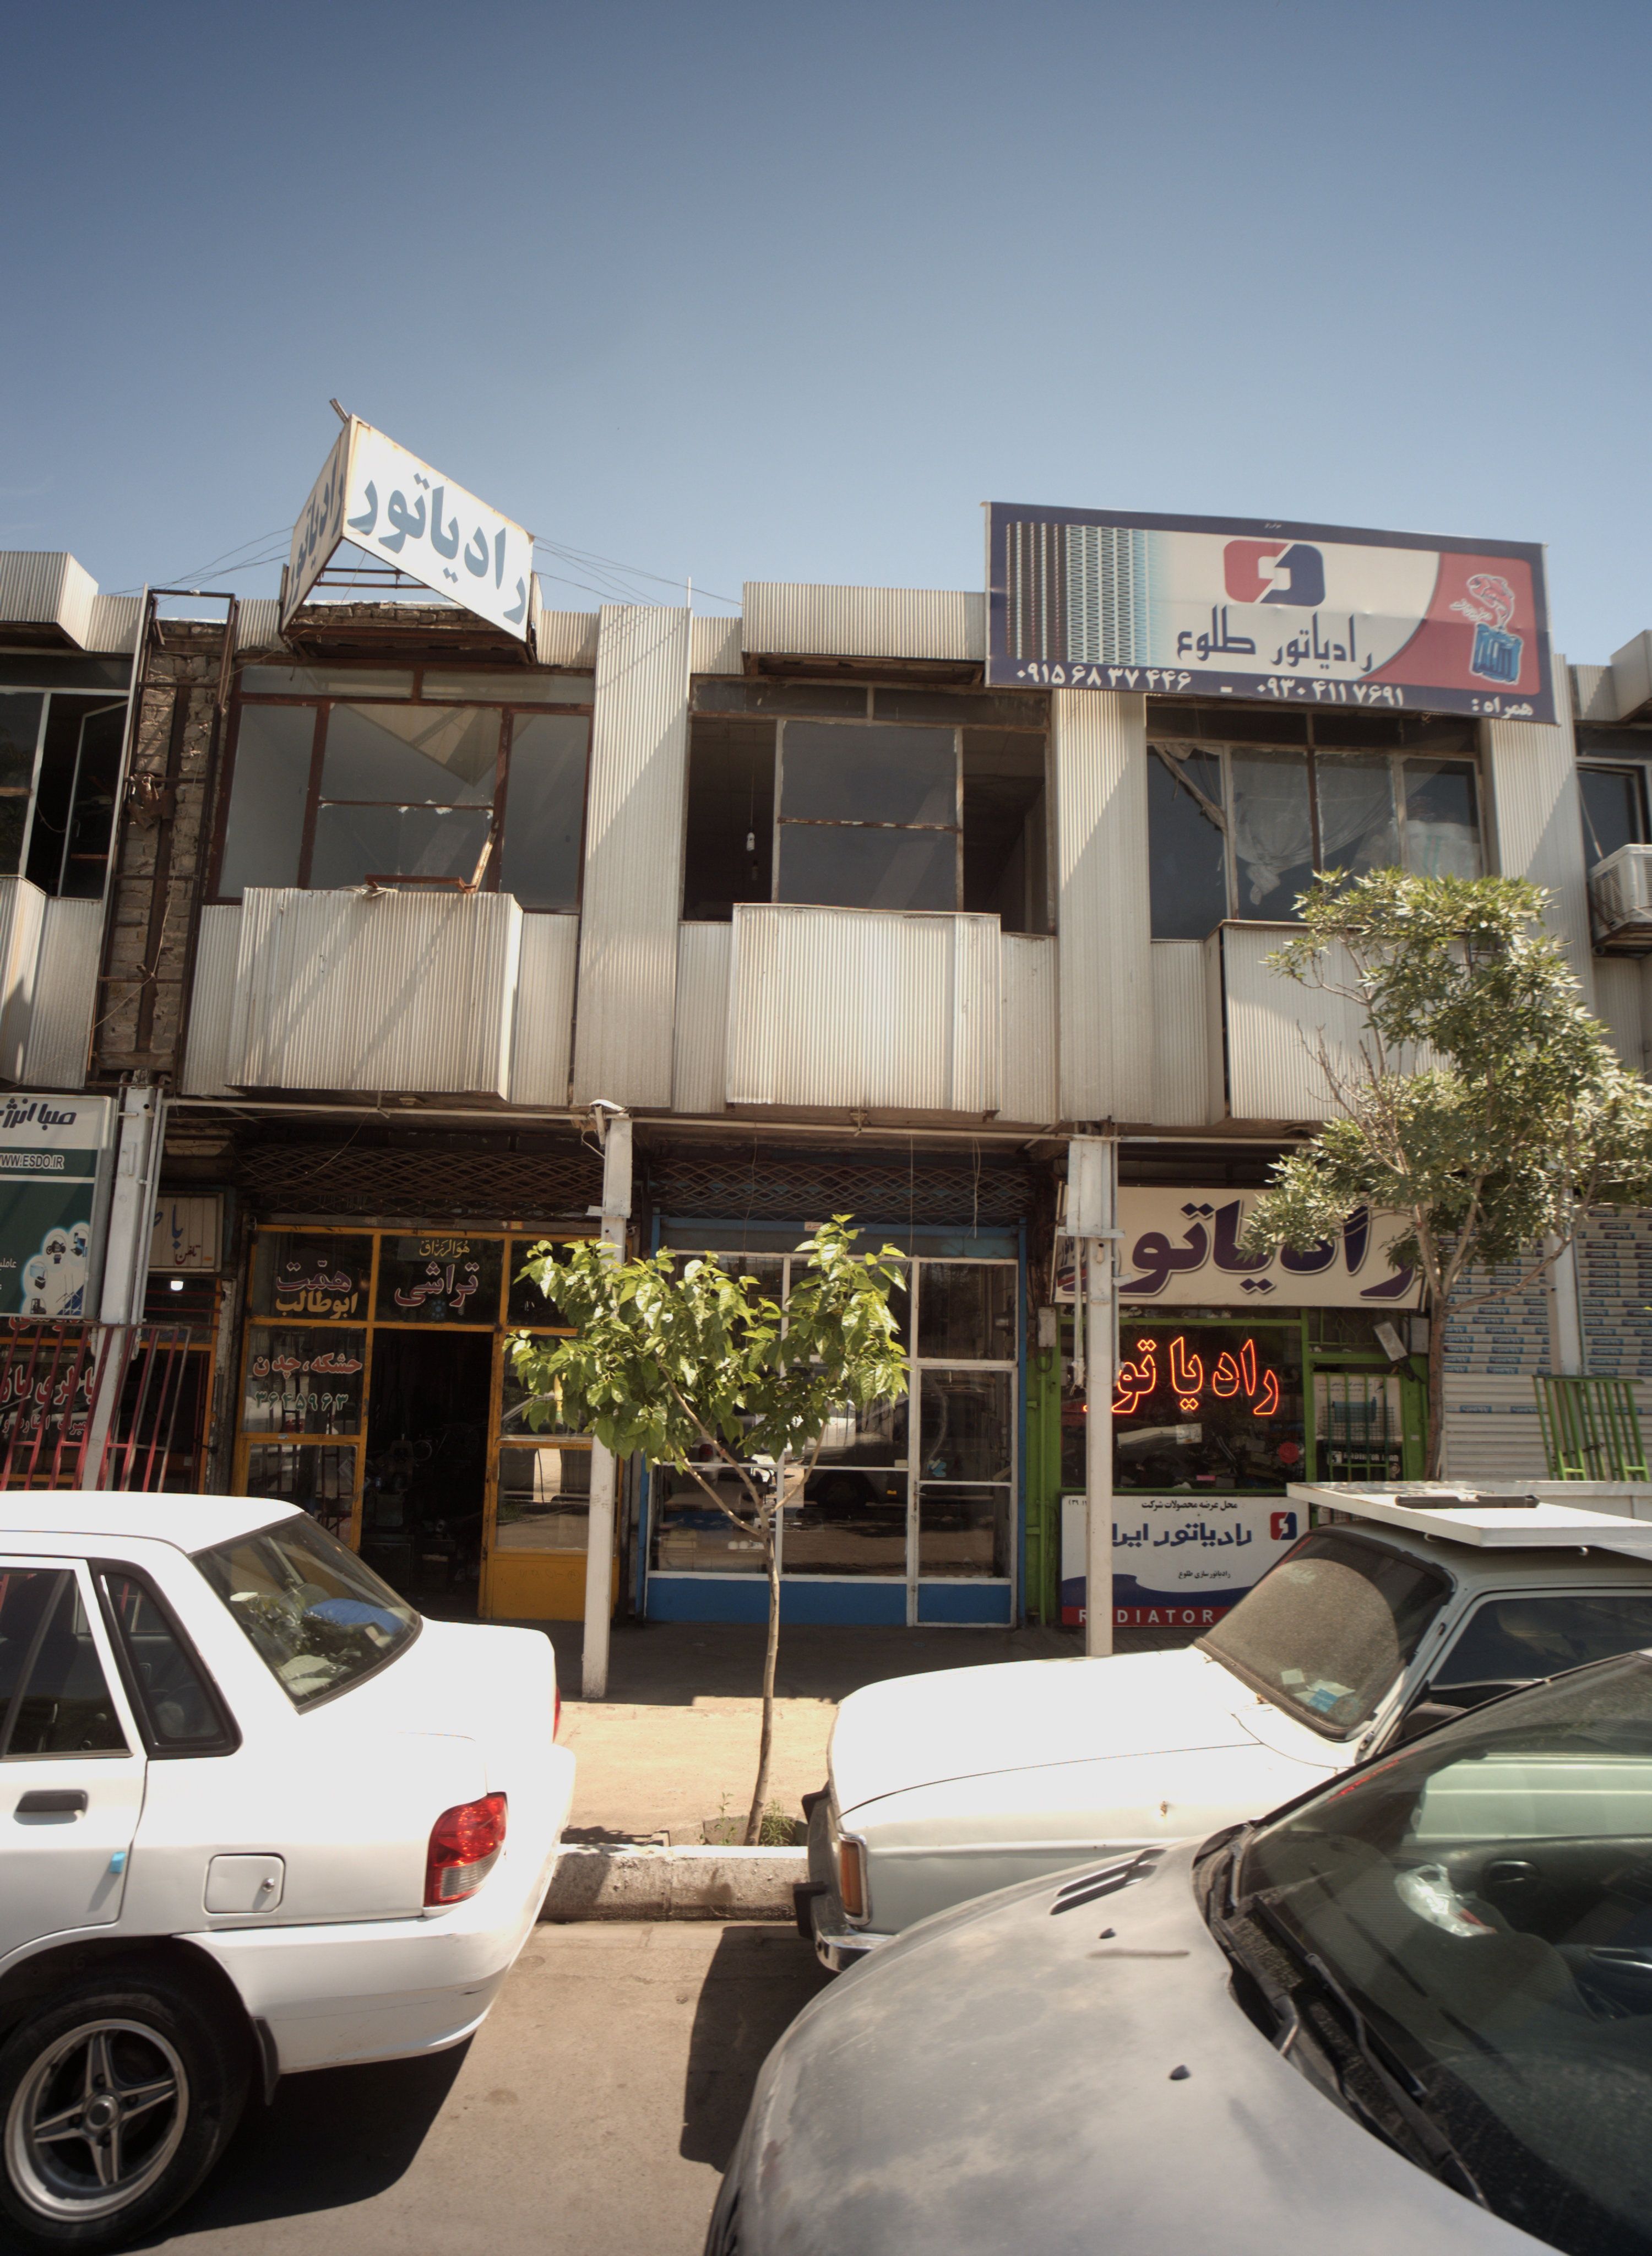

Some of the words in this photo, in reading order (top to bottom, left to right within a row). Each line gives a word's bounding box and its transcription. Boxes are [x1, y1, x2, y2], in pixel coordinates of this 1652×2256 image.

[347, 472, 526, 626] رادیاتور
[1177, 604, 1256, 661] طلوع
[1270, 610, 1373, 673] رادیاتور
[37, 1103, 77, 1131] صبا
[0, 1154, 64, 1169] WW.ESDO.IR
[394, 1261, 480, 1307] تراشی
[275, 1289, 358, 1320] ابوطالب
[253, 1354, 301, 1379] چدن
[1141, 1500, 1164, 1511] شرکت
[1164, 1500, 1198, 1511] محصولات
[1199, 1500, 1219, 1511] عرضه
[1220, 1500, 1238, 1511] محل
[1112, 1523, 1149, 1548] ایرا
[1153, 1522, 1252, 1547] رادیاتور
[1079, 1609, 1214, 1624] RDIATOR
